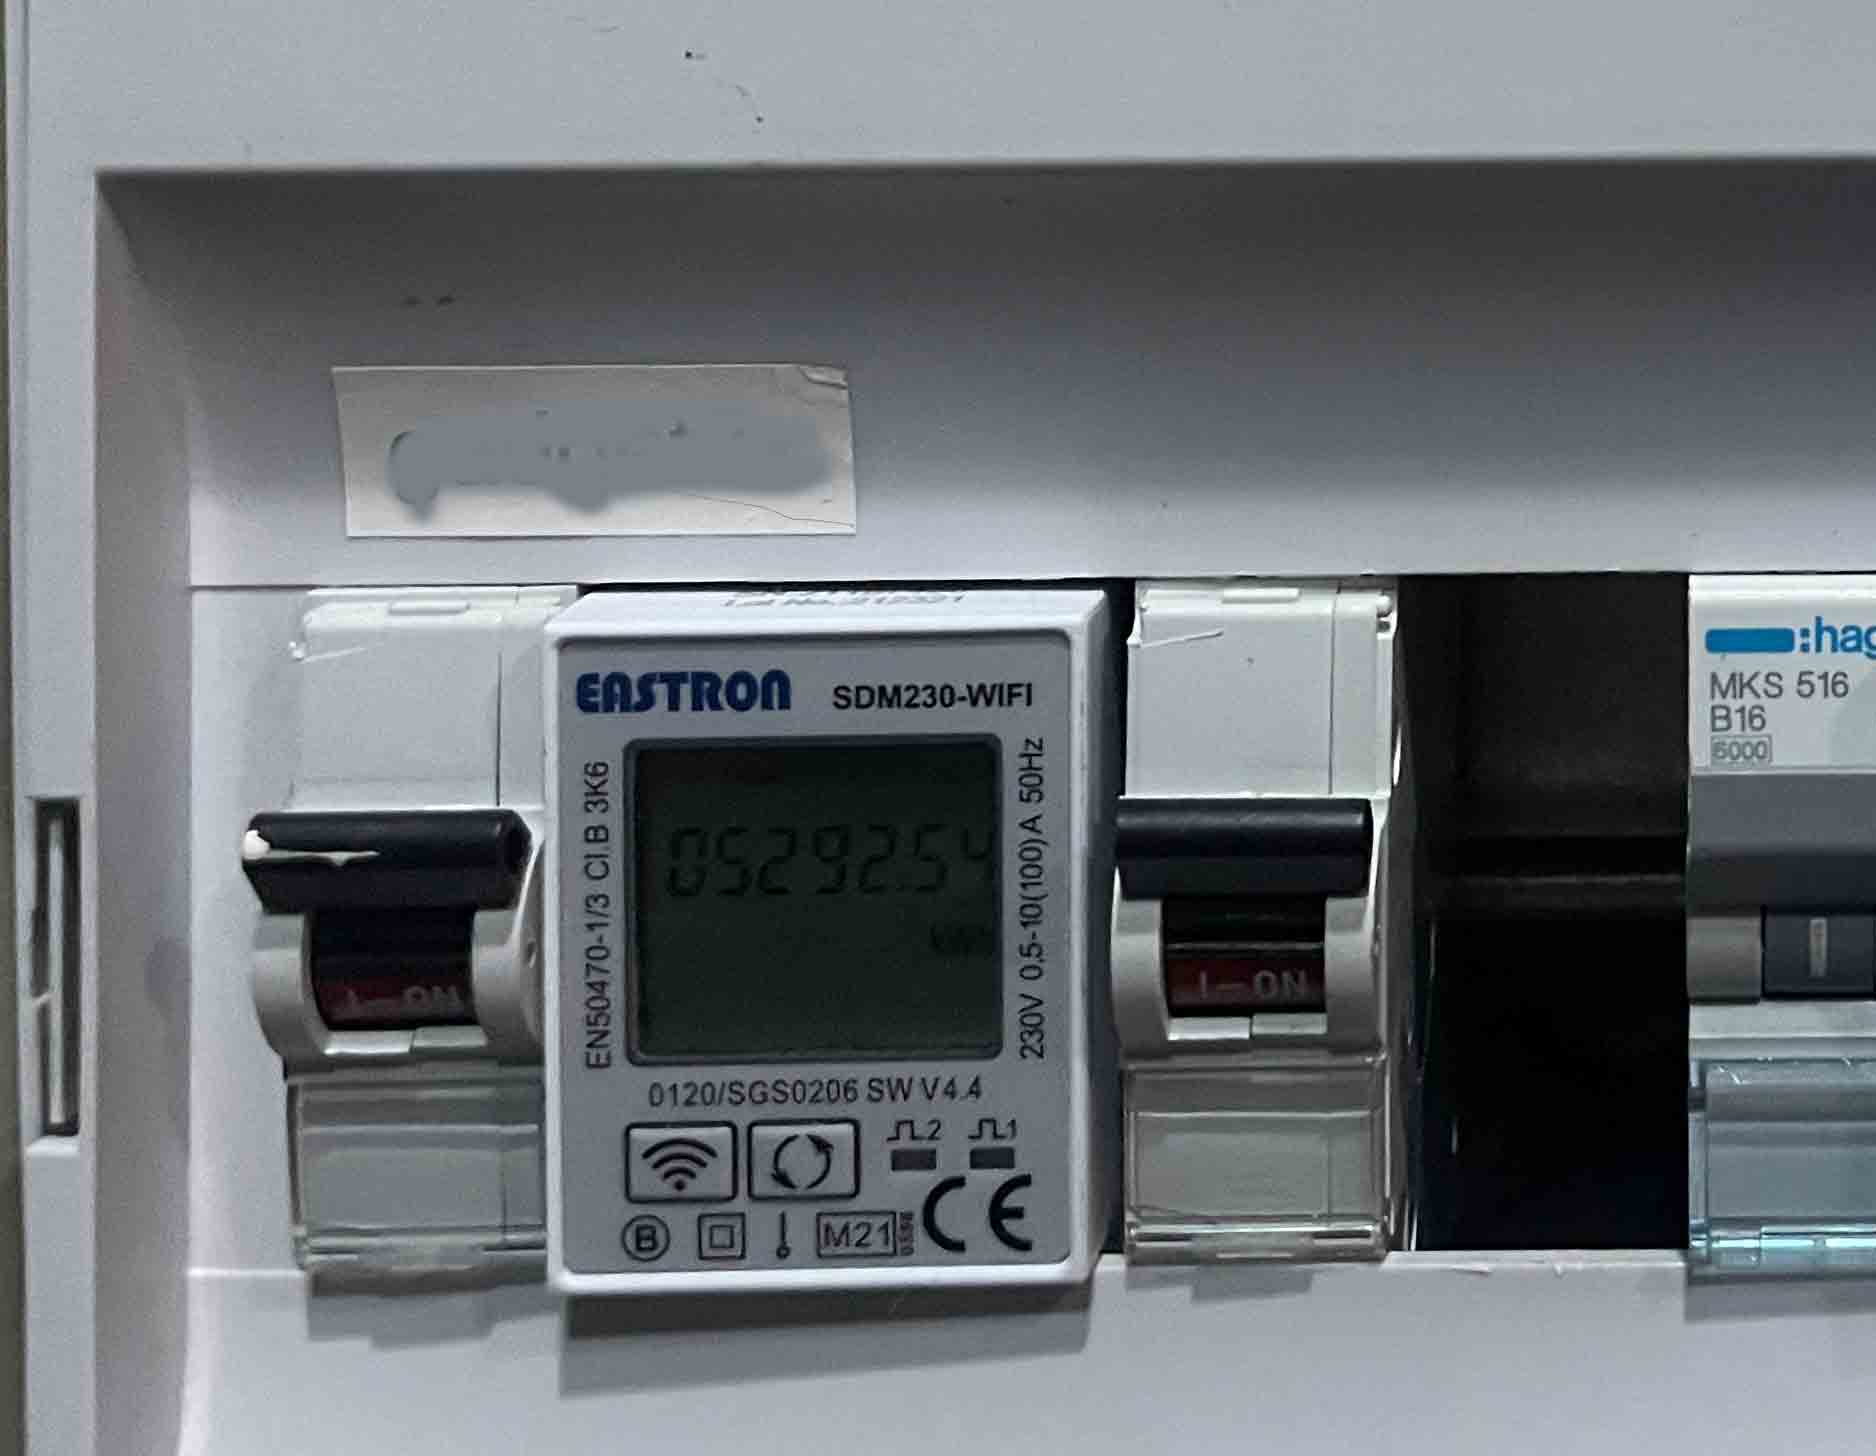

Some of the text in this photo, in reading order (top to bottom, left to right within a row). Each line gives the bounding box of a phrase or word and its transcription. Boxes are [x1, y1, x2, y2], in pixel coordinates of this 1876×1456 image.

[576, 670, 791, 713] EASTRON
[832, 683, 1032, 710] SDM230-WIFI
[1710, 671, 1849, 700] MKS 516
[1710, 704, 1766, 733] B16
[584, 761, 610, 814] 3K6
[1018, 737, 1045, 804] 50Hz
[584, 893, 612, 1069] EN50470-1/3
[1018, 993, 1045, 1059] 230V
[648, 1077, 859, 1107] 0120/SGS0206
[866, 1076, 914, 1101] SW
[824, 1221, 889, 1247] M21
